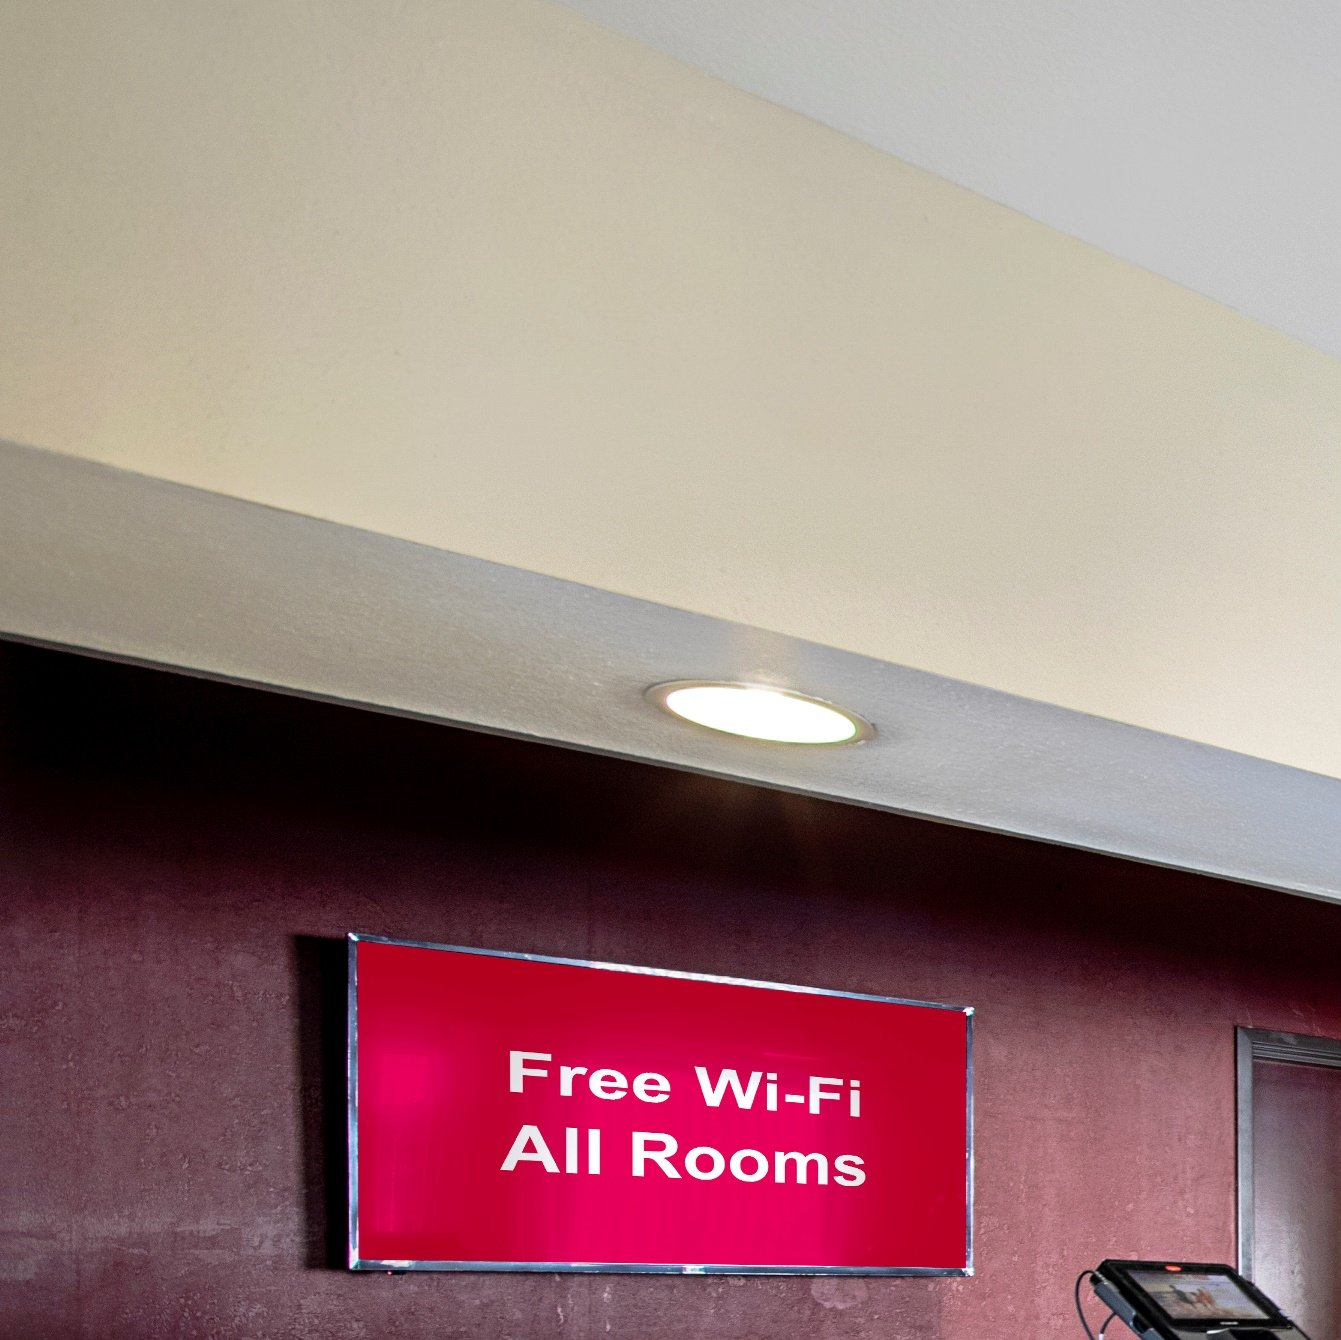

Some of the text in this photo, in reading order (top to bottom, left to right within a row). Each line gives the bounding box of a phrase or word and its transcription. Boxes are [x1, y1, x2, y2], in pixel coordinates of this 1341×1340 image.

[509, 1050, 862, 1117] Free Wi-Fi
[500, 1124, 867, 1187] All Rooms
